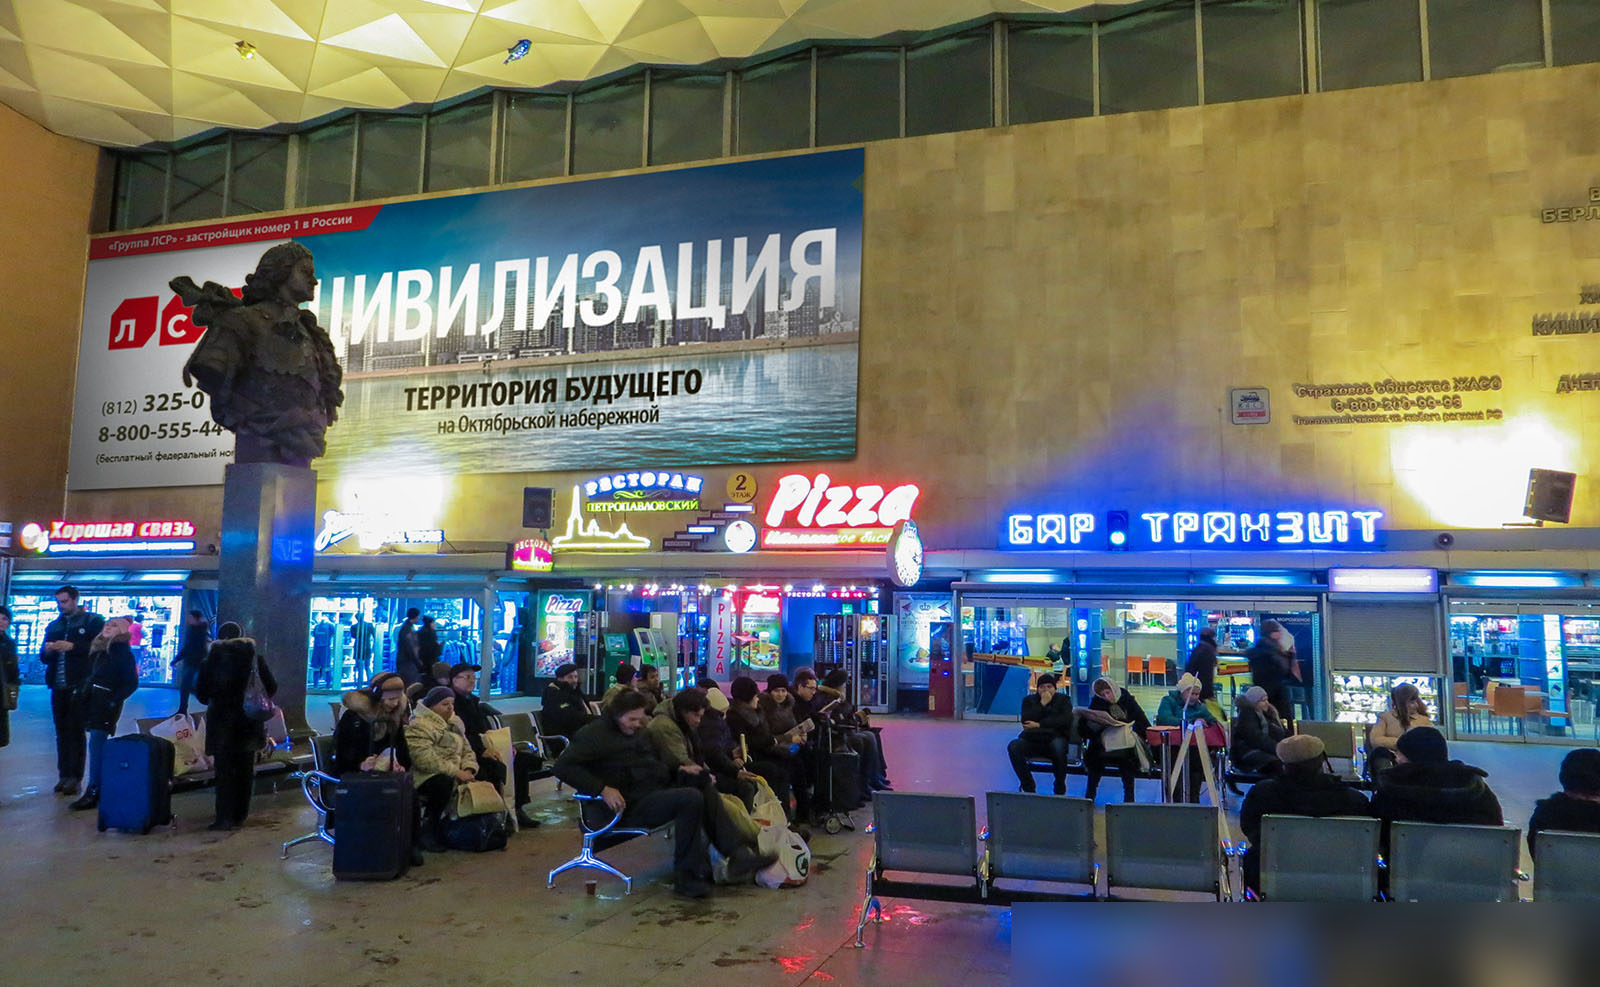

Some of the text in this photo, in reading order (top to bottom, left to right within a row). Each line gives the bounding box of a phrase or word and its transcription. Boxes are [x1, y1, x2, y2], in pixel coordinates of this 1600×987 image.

[108, 239, 149, 252] «Группа
[151, 235, 178, 247] ЛСР»
[186, 227, 252, 244] застройщик
[254, 223, 290, 238] номер
[294, 220, 299, 230] 1
[303, 221, 309, 229] в
[312, 215, 352, 228] России
[308, 228, 837, 357] ЦИВИЛИЗАЦИЯ
[404, 368, 703, 411] ТЕРРИТОРИЯ БУДУЩЕГО
[1296, 376, 1502, 399] Страховое общество ЖАСО
[101, 391, 205, 416] (812) 325-0
[438, 405, 659, 436] на Октябрьской набережной
[96, 452, 153, 465] (бесплатный
[155, 449, 217, 462] федеральный
[585, 471, 704, 497] РЕСТОРАН
[735, 474, 747, 491] 2
[586, 498, 699, 513] ПЕТРОПАВЛОВСКИЙ
[765, 473, 920, 528] Pizza
[51, 521, 196, 543] Хорошая связь
[1009, 511, 1384, 545] БАР ТРАНЗИТ
[545, 595, 583, 613] Pizza
[715, 603, 726, 674] PIZZA
